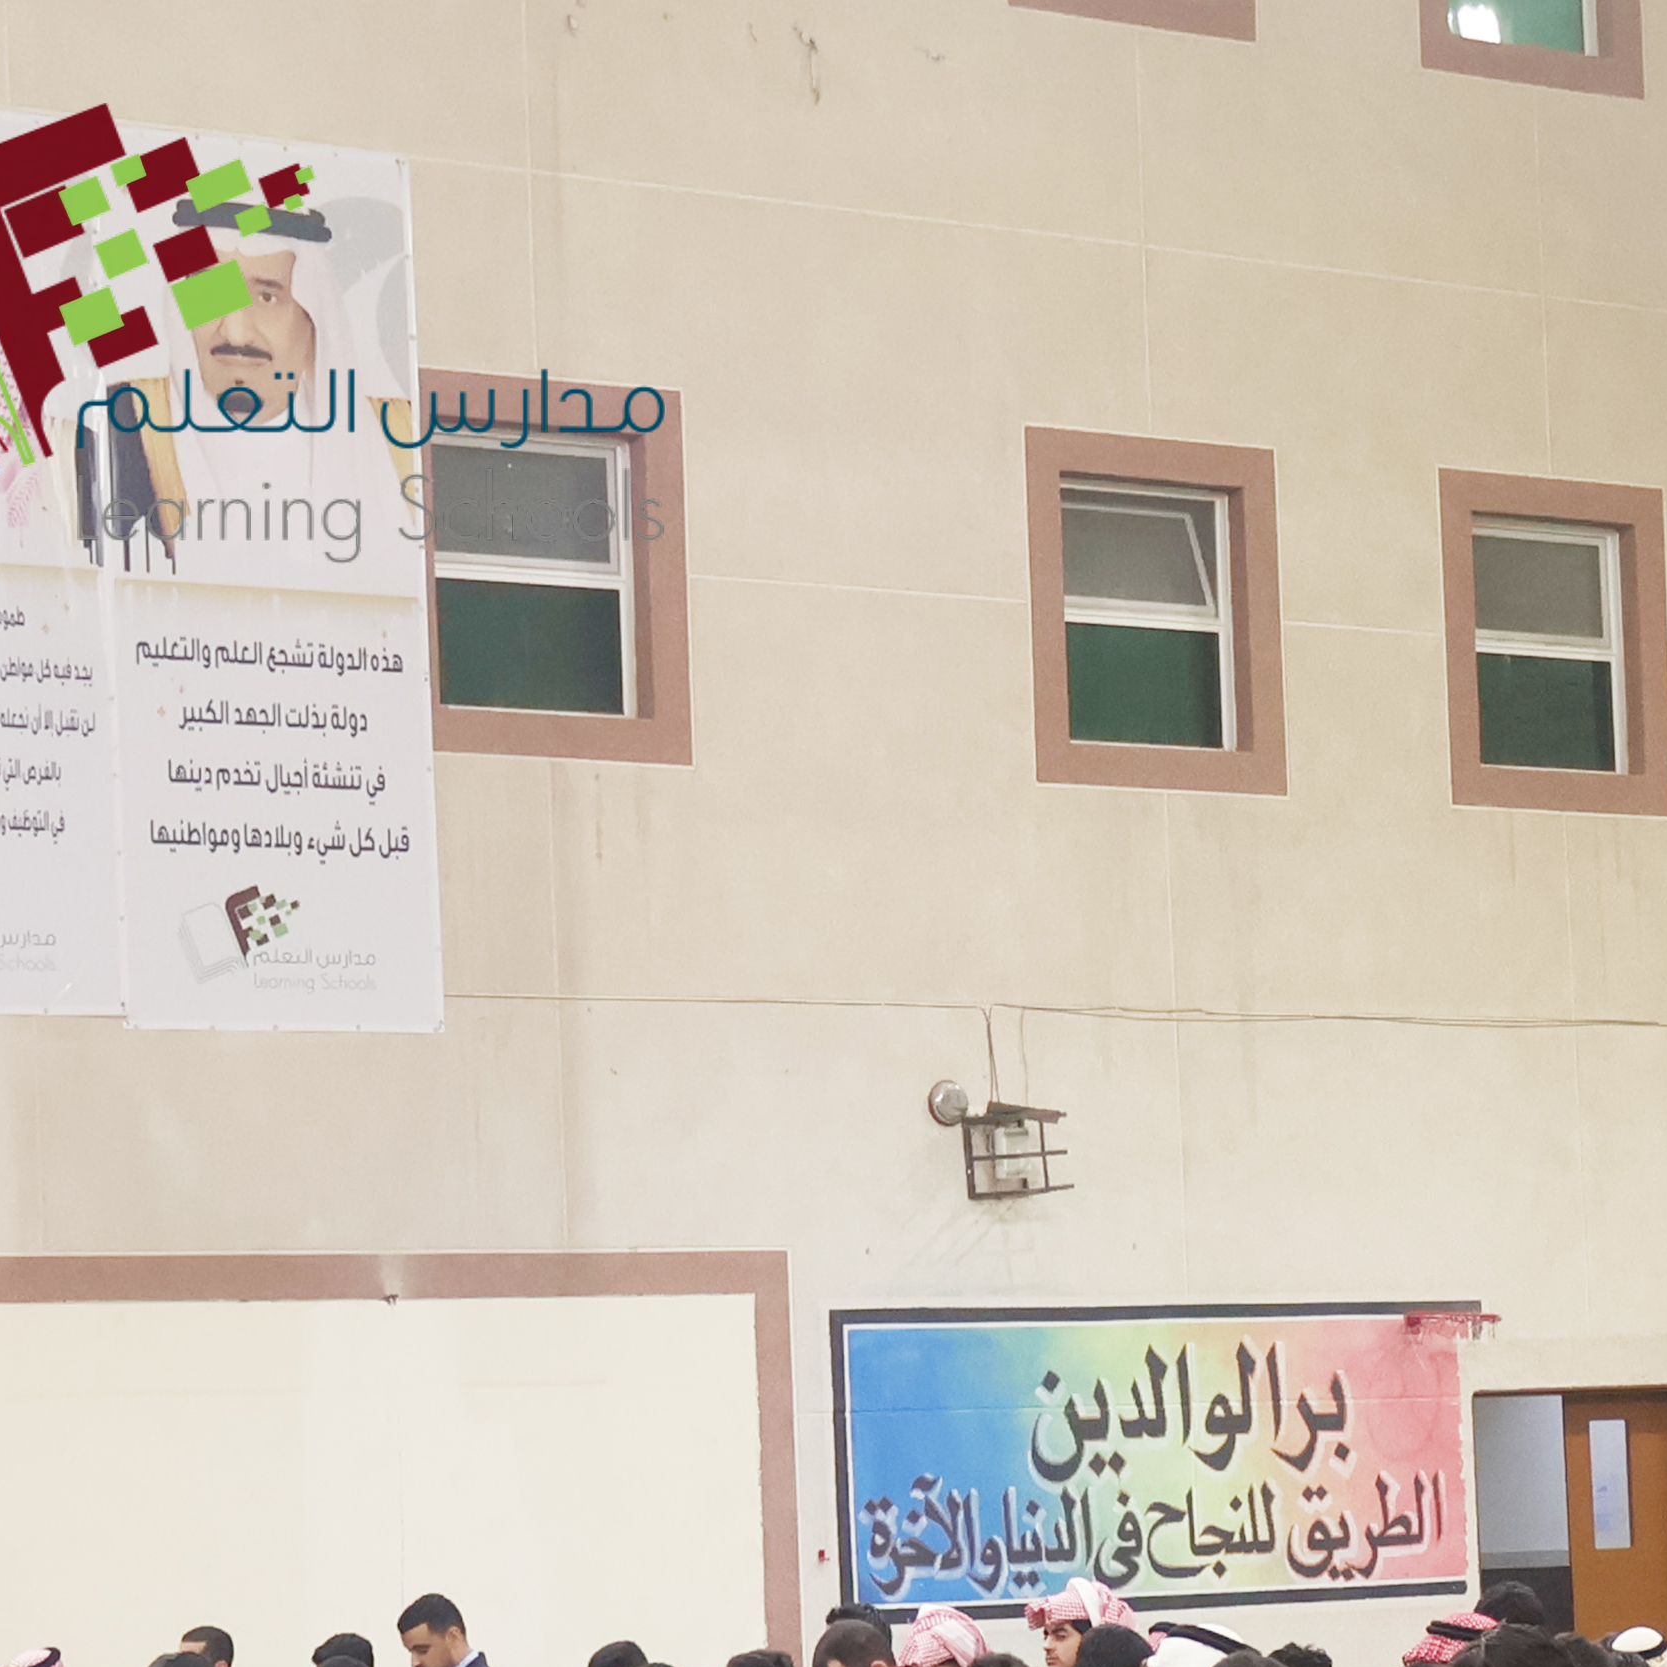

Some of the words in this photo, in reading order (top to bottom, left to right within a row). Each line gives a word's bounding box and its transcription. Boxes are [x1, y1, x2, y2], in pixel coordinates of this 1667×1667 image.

[136, 636, 211, 669] والتعليم
[215, 640, 262, 669] العلم
[266, 638, 314, 674] تشجع
[318, 643, 368, 677] الدولة
[370, 647, 403, 673] هذه
[36, 658, 52, 683] كل
[178, 698, 229, 732] الكبير
[234, 702, 281, 735] الجهد
[285, 703, 327, 738] بذلت
[331, 703, 368, 738] دولة
[168, 758, 212, 792] دينها
[216, 760, 261, 791] تخدم
[265, 757, 309, 796] أجيال
[312, 761, 362, 791] تنشئة
[366, 766, 386, 806] في
[150, 819, 241, 853] ومواطنيها
[244, 823, 303, 856] وبلادها
[307, 820, 346, 865] شيء
[349, 826, 376, 857] كل
[379, 825, 410, 860] قبل
[1032, 1340, 1284, 1483] الوالدين
[1002, 1486, 1092, 1588] الدنيا
[1147, 1480, 1276, 1580] للنجاح
[1287, 1471, 1443, 1580] الطريق
